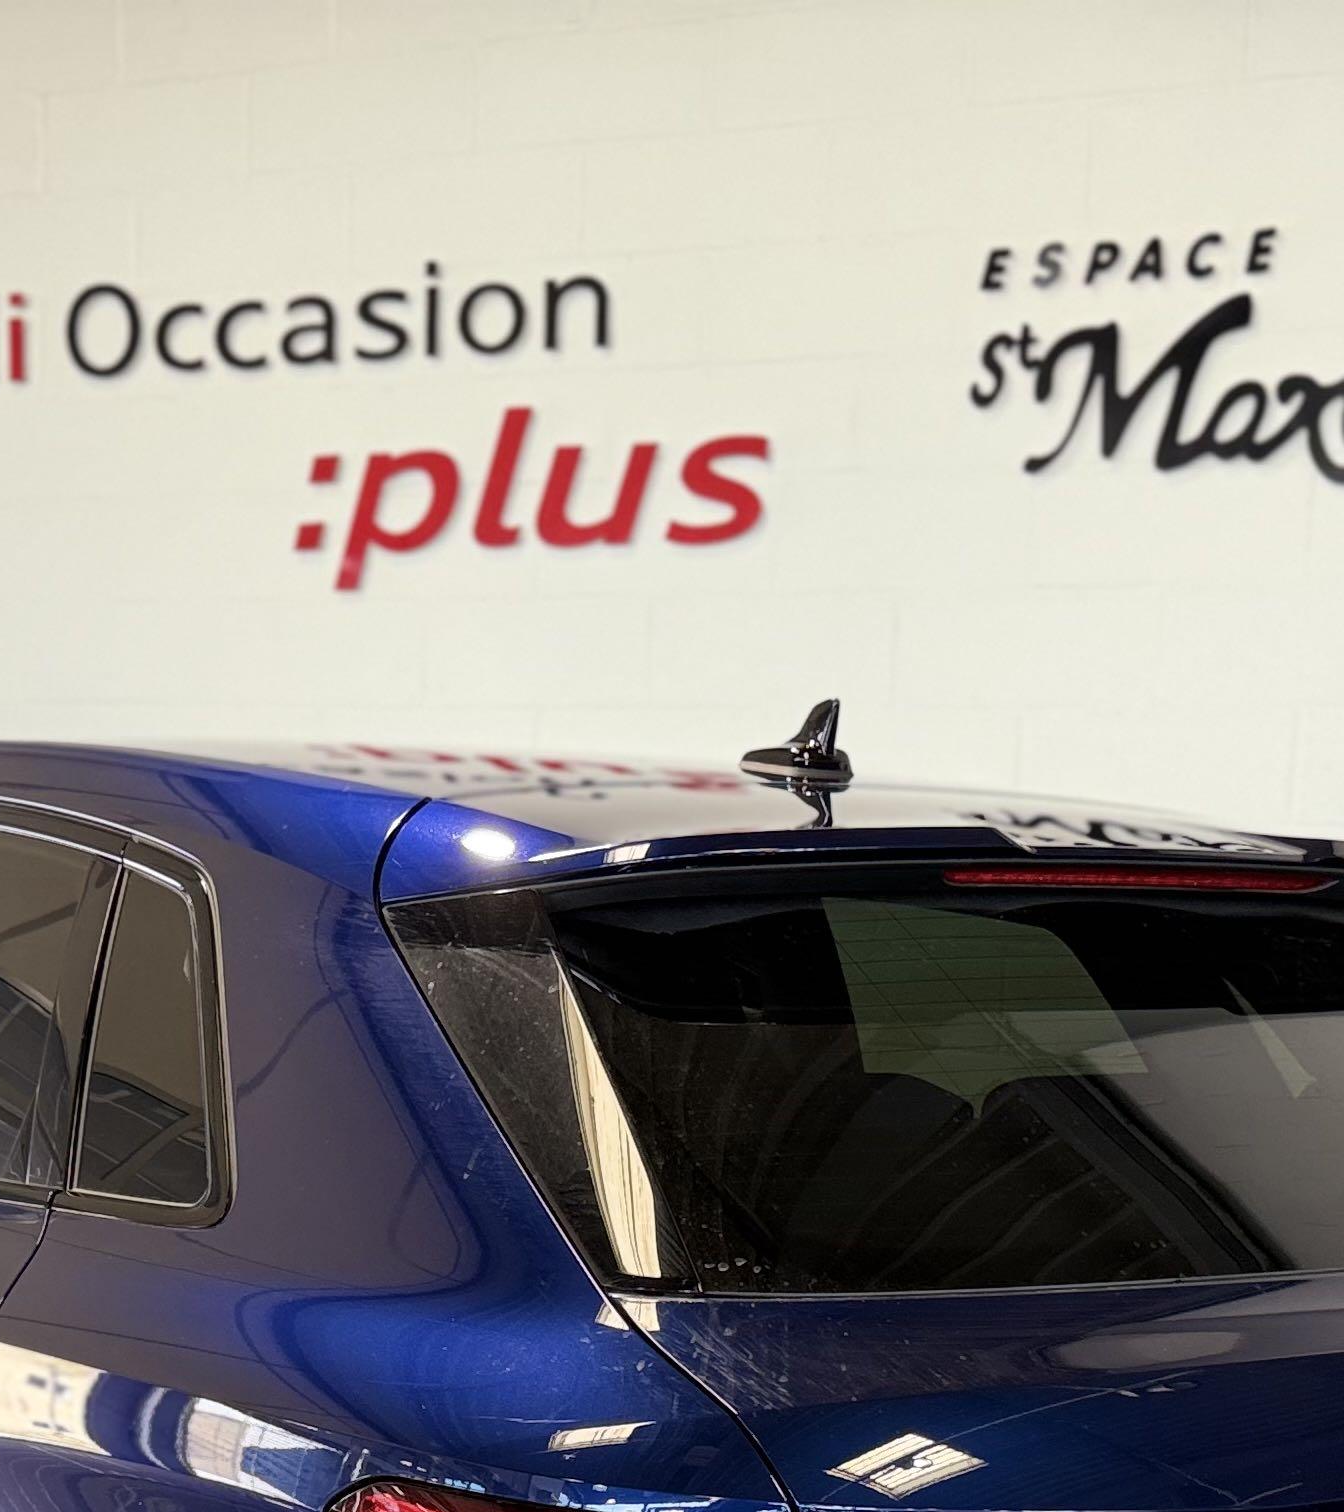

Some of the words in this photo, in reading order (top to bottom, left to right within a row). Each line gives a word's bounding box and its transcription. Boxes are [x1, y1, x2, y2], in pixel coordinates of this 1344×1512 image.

[980, 227, 1277, 292] ESPACE
[64, 260, 612, 379] Occasion
[294, 407, 771, 591] :plus
